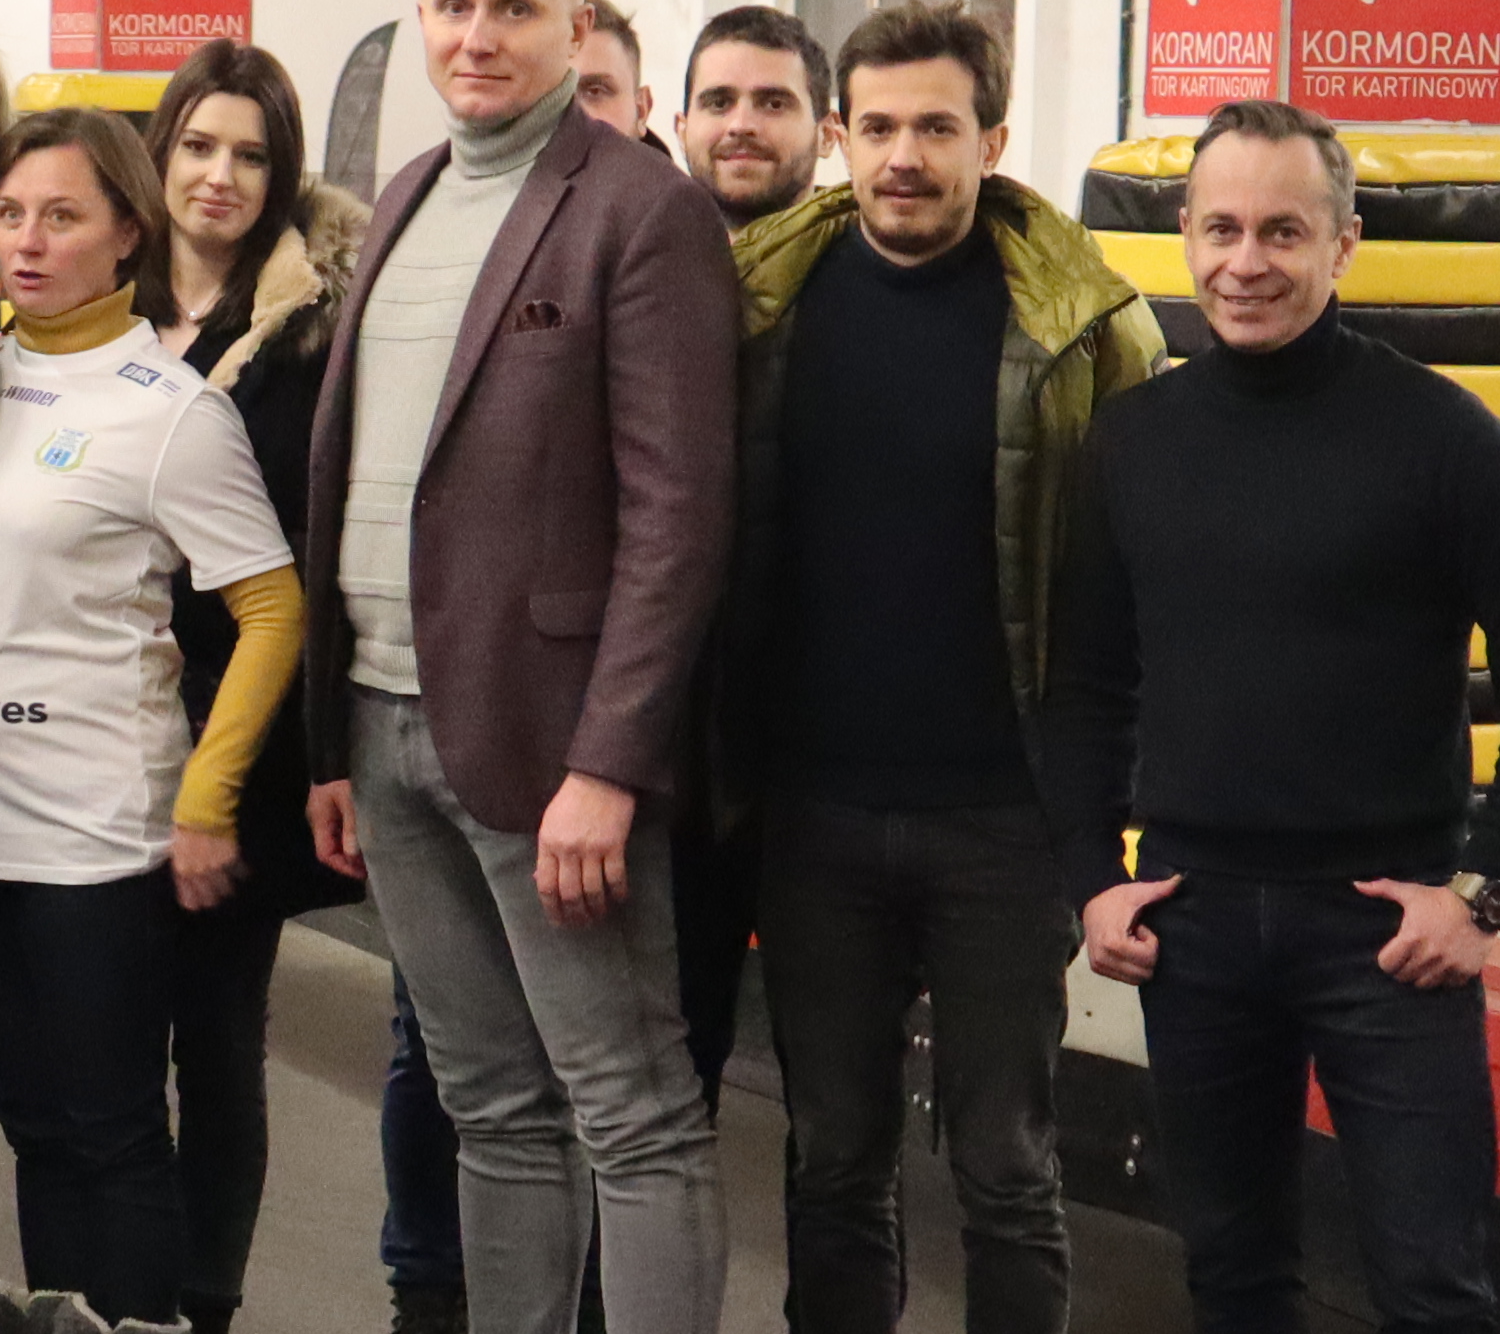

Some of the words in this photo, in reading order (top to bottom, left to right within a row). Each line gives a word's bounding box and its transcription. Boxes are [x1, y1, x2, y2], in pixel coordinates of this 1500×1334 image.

[108, 14, 244, 36] KORMORAN
[1151, 30, 1274, 65] KORMORAN
[1151, 75, 1177, 98] TOR
[1181, 75, 1271, 99] KARTINGOWY
[1302, 75, 1347, 99] TOR
[1353, 75, 1500, 100] KARTINGOWY
